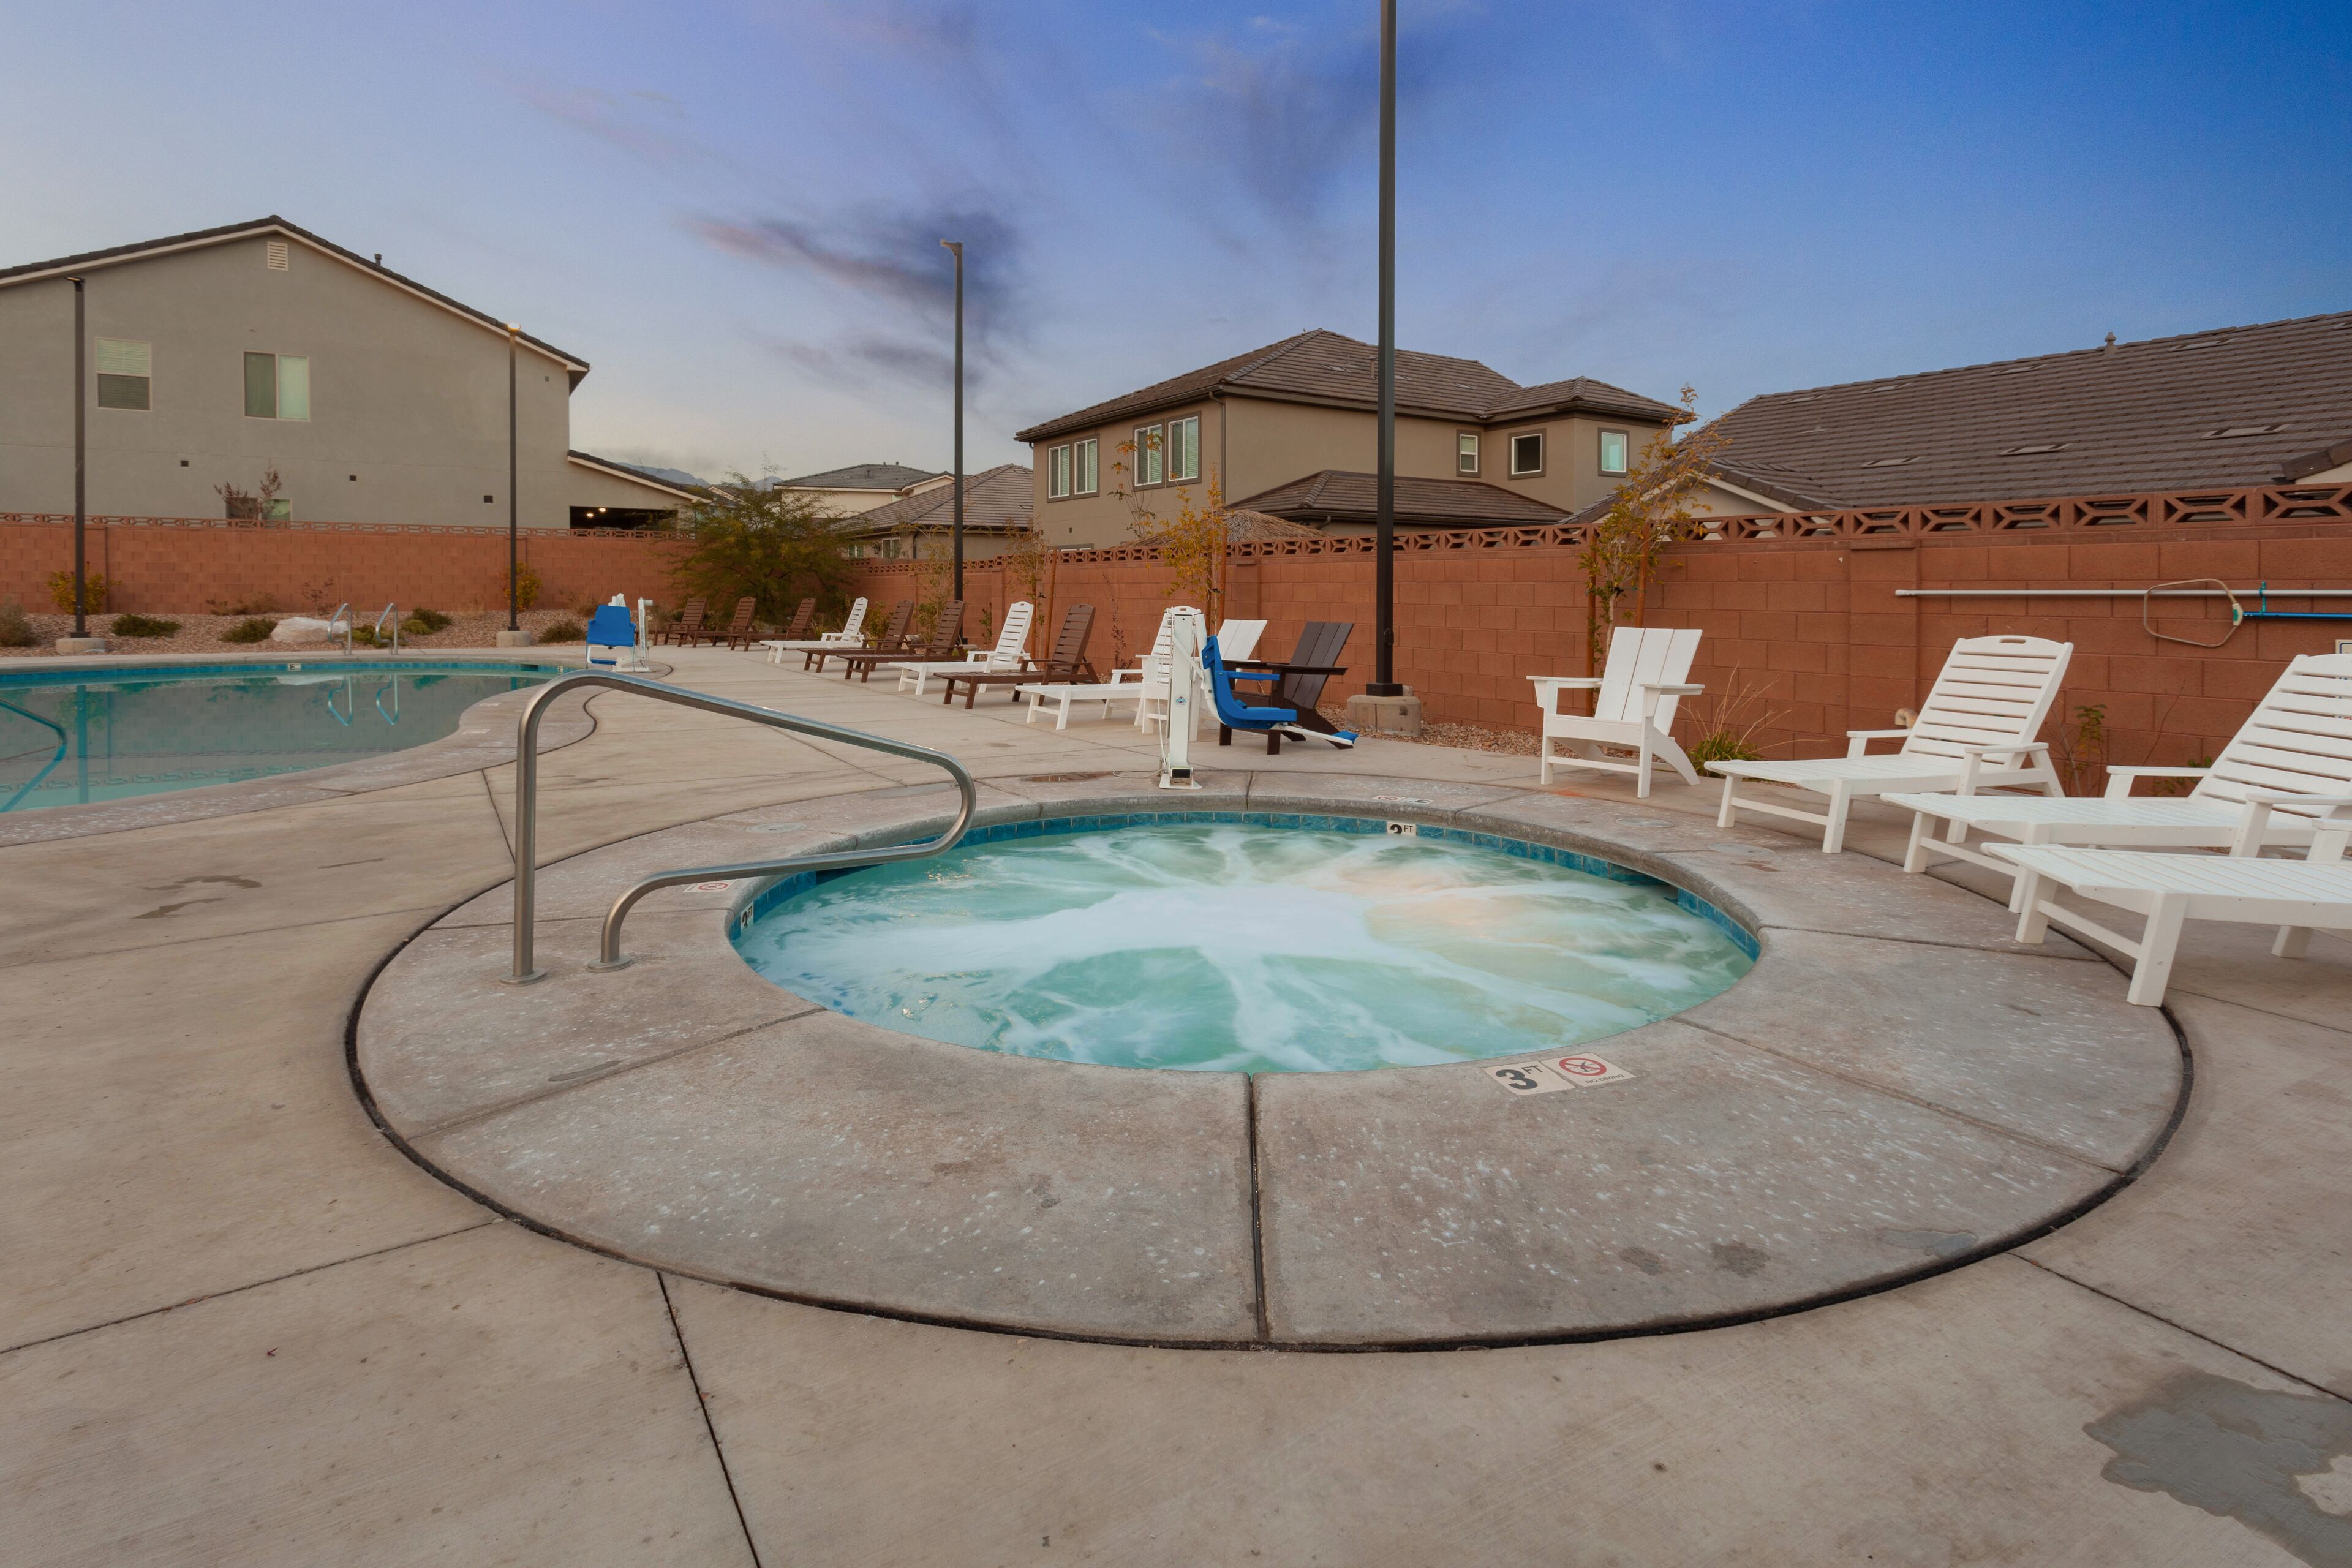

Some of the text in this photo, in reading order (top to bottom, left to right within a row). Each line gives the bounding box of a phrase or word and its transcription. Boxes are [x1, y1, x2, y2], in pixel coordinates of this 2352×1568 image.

[1495, 1065, 1544, 1090] 3 FT
[1598, 1074, 1625, 1082] DIVING
